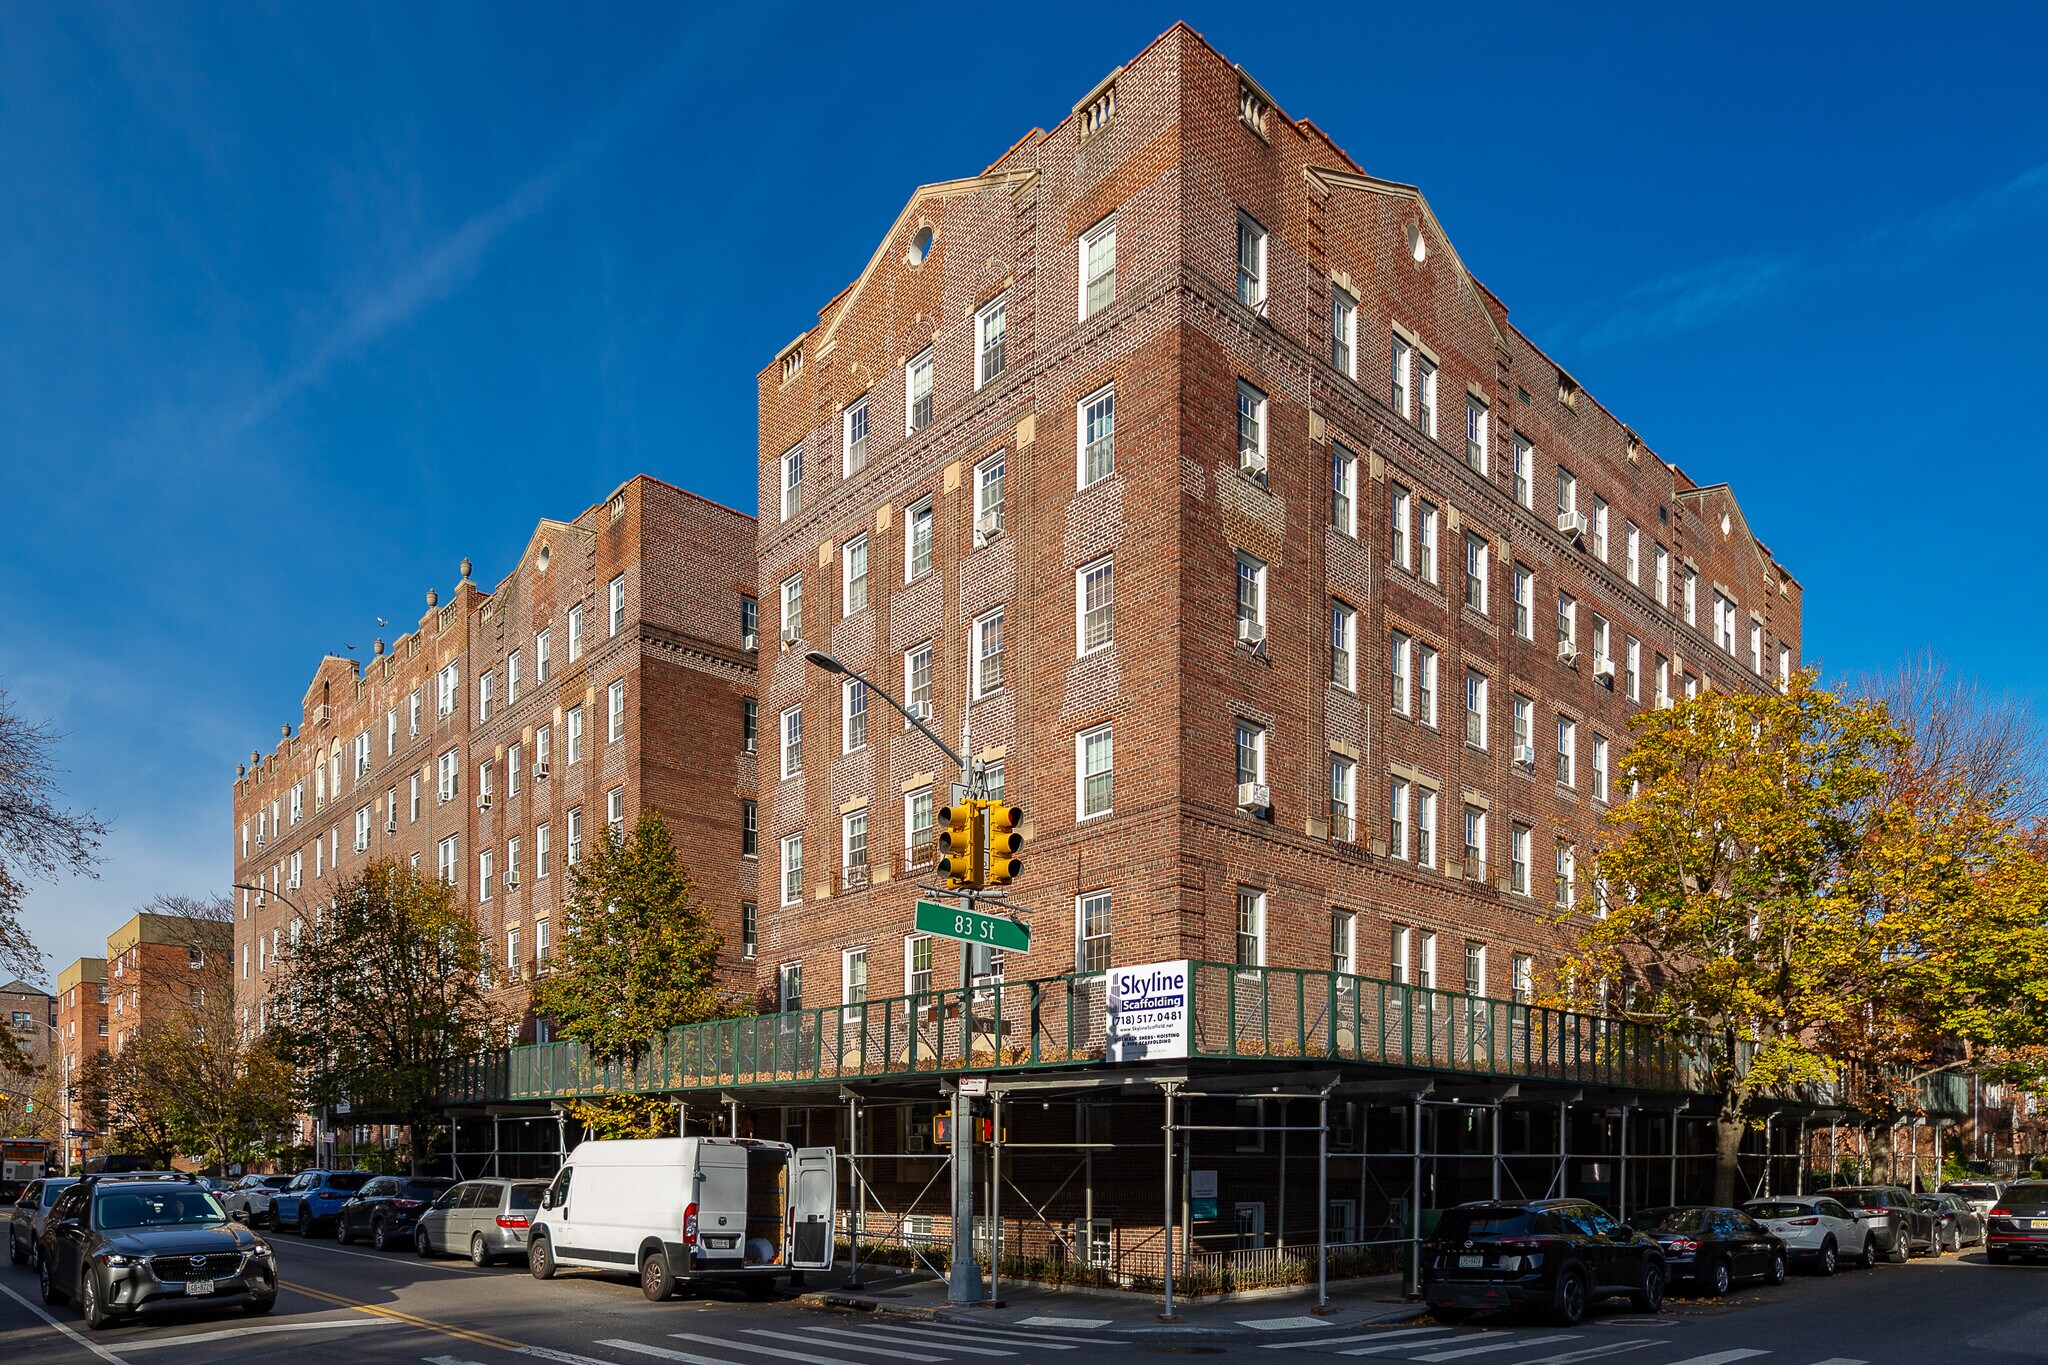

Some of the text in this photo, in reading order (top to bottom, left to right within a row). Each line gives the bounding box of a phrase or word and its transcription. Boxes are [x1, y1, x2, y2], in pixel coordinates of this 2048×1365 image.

[954, 914, 995, 941] 83 St
[1121, 970, 1184, 999] Skyline
[1123, 997, 1181, 1011] Scaffolding
[1112, 1010, 1182, 1027] (718) 517.0481
[1114, 1035, 1137, 1043] SIDEWALK
[1139, 1038, 1171, 1046] SCAFFOLDING
